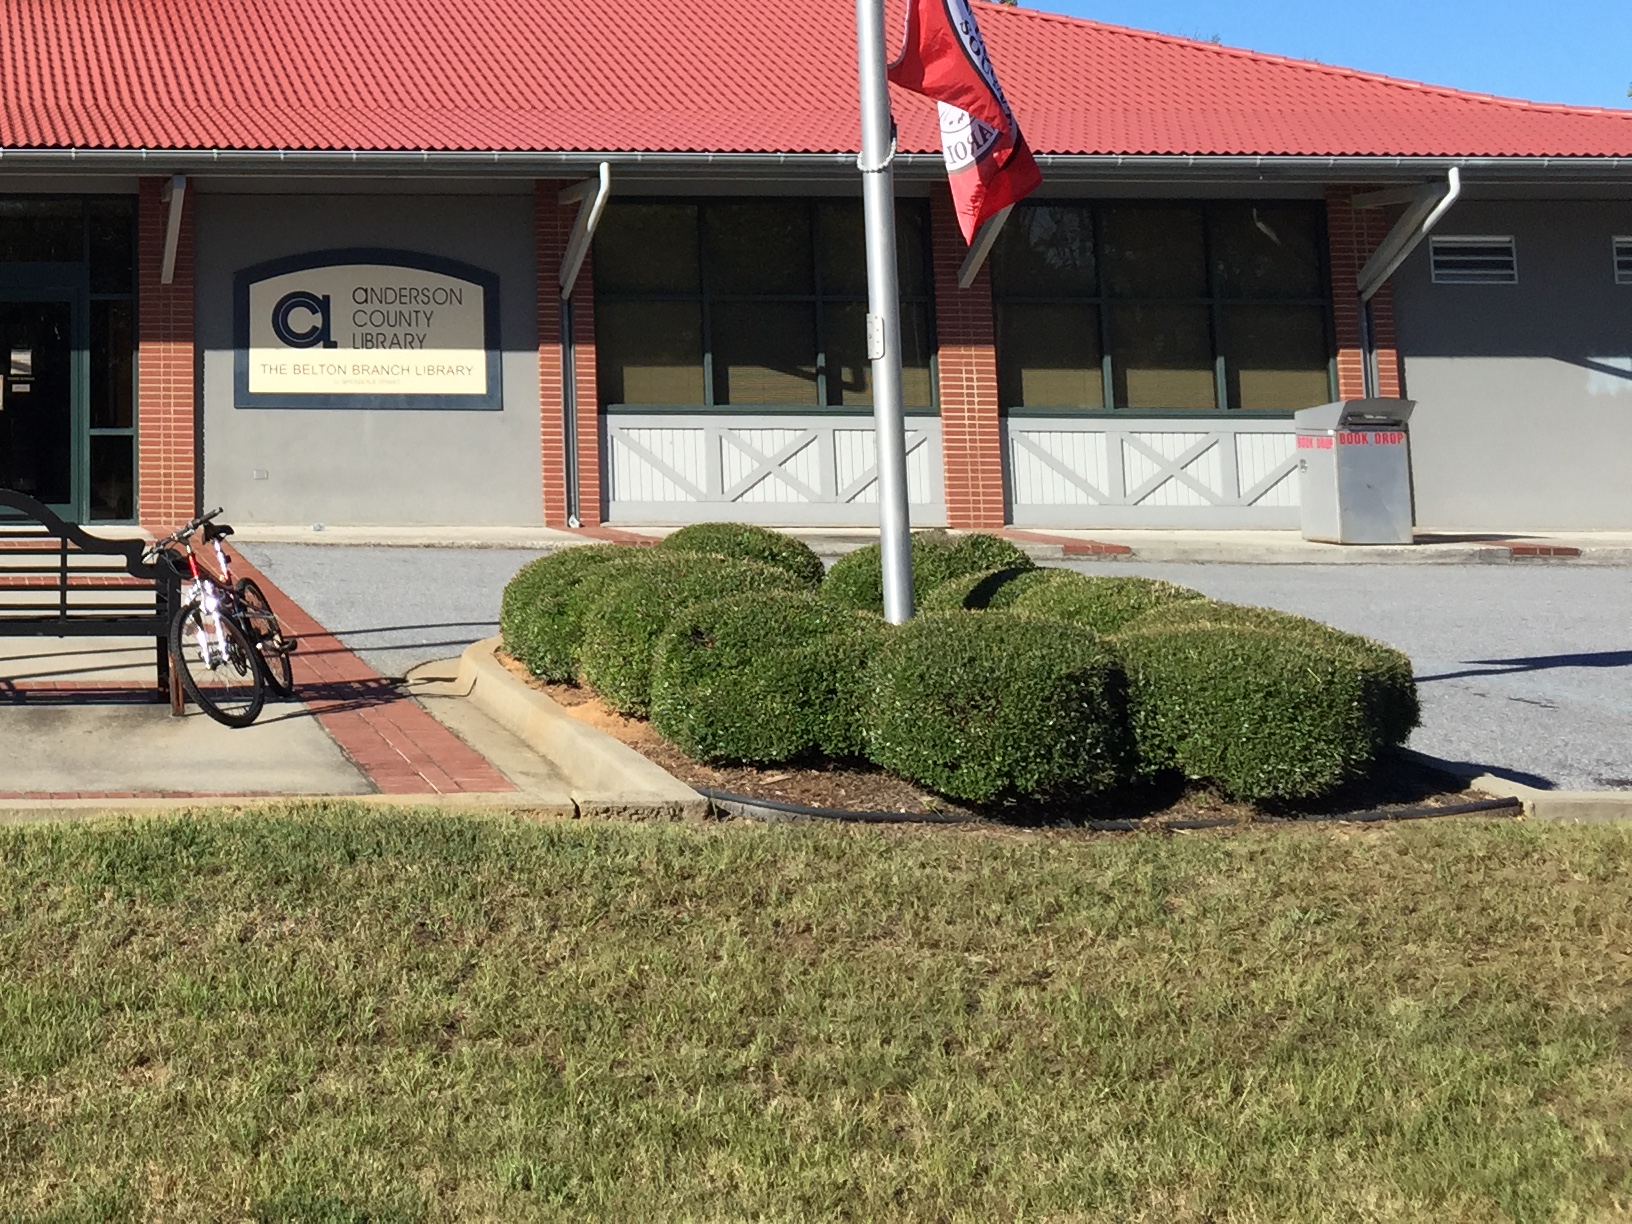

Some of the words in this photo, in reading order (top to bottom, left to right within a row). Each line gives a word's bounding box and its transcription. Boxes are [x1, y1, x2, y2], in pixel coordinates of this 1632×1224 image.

[352, 309, 434, 328] COUNTY
[352, 333, 427, 350] LIBRARY
[261, 364, 287, 376] THE
[293, 364, 347, 376] BELTON
[352, 364, 410, 376] BRANCH
[415, 364, 474, 377] LIBRARY
[1339, 432, 1368, 445] BOOK
[1374, 432, 1404, 445] DROP
